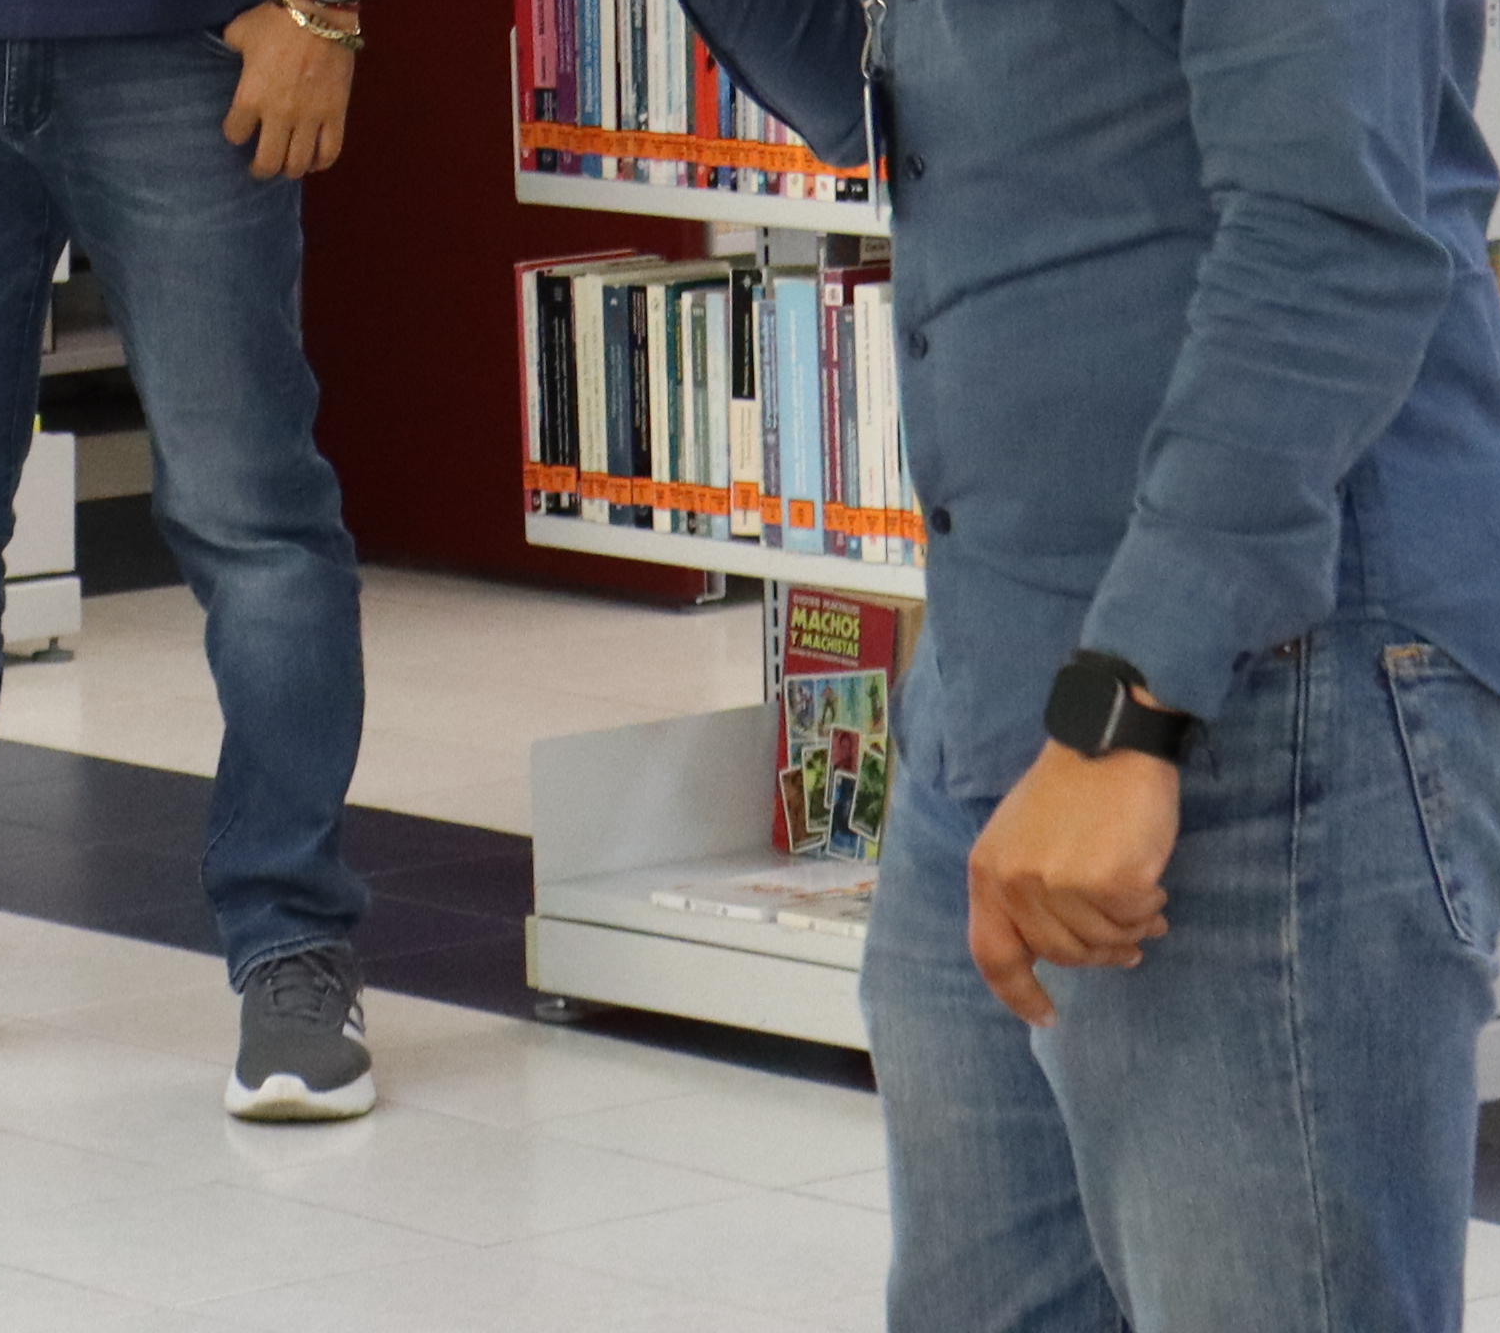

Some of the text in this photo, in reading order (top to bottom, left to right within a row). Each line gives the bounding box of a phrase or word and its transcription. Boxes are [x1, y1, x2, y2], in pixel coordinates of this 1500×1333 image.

[791, 605, 860, 641] MACHOS
[790, 630, 800, 647] Y
[801, 633, 860, 659] MACHISTAS
